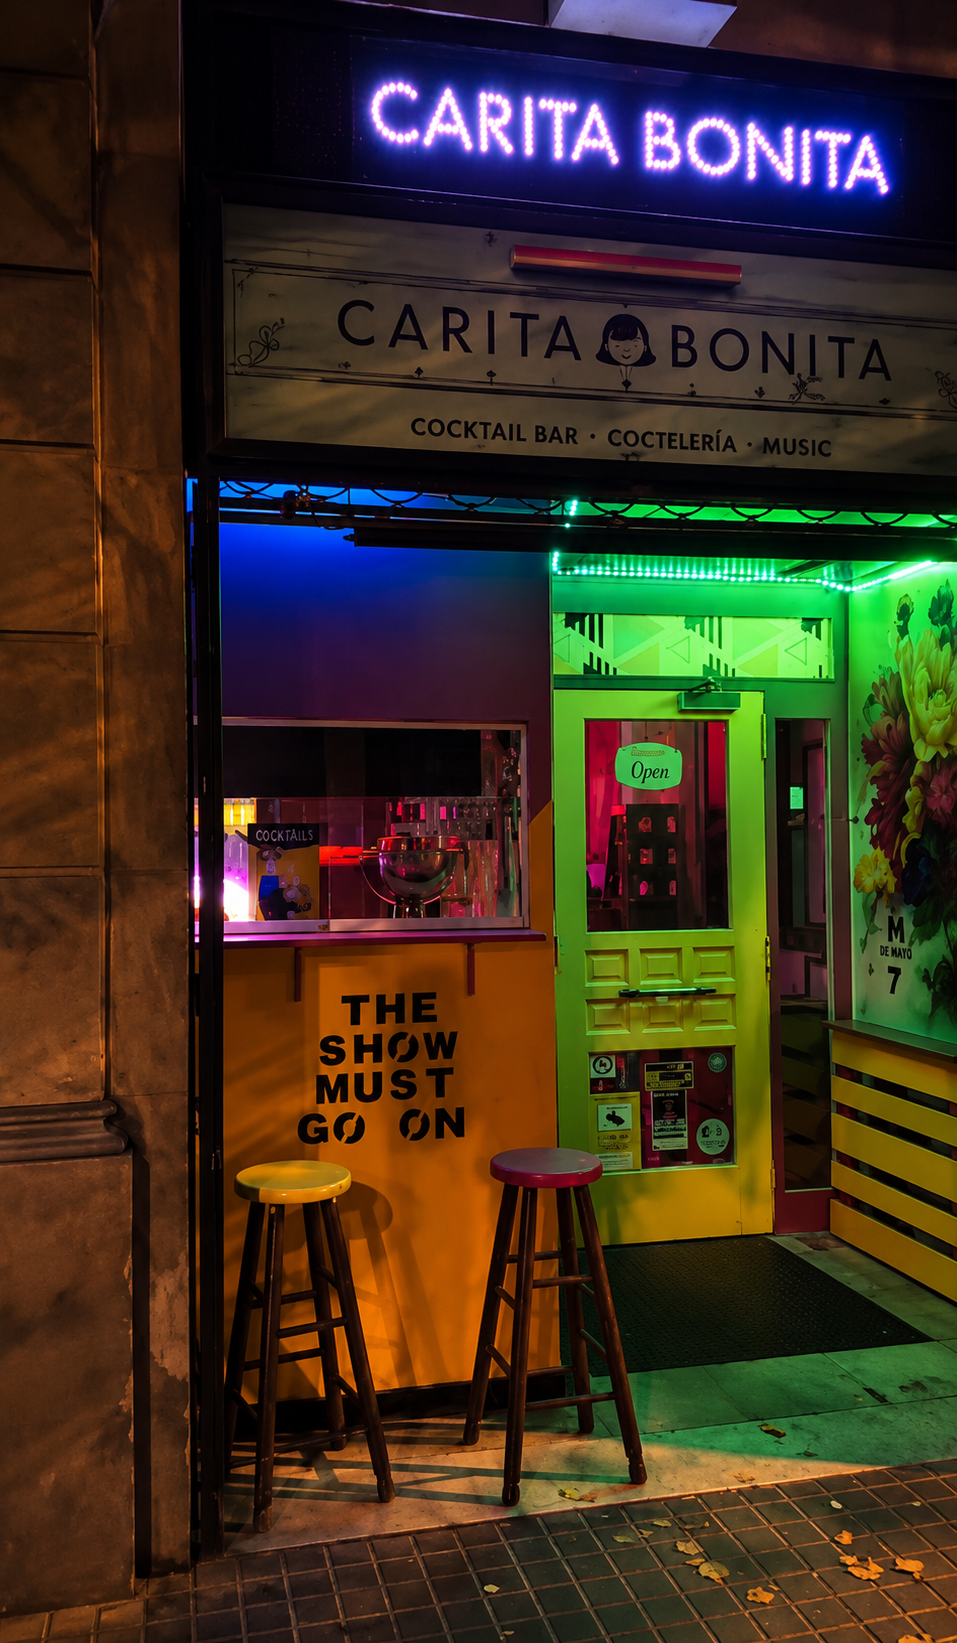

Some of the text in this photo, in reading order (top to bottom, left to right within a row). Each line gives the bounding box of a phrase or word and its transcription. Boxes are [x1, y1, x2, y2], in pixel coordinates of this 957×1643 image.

[368, 79, 890, 195] CARITA BONITA
[336, 299, 892, 382] CARITA BONITA
[410, 417, 833, 459] COCKTAIL BAR COCTELERÍA MUSIC
[631, 760, 670, 784] Open
[255, 828, 314, 842] COCKTAILS
[887, 915, 905, 943] M
[880, 945, 912, 960] DE MAYO
[887, 965, 902, 994] 7
[341, 992, 438, 1026] THE
[319, 1031, 458, 1066] SHOW
[316, 1067, 454, 1104] MUST
[297, 1107, 465, 1145] GO ON
